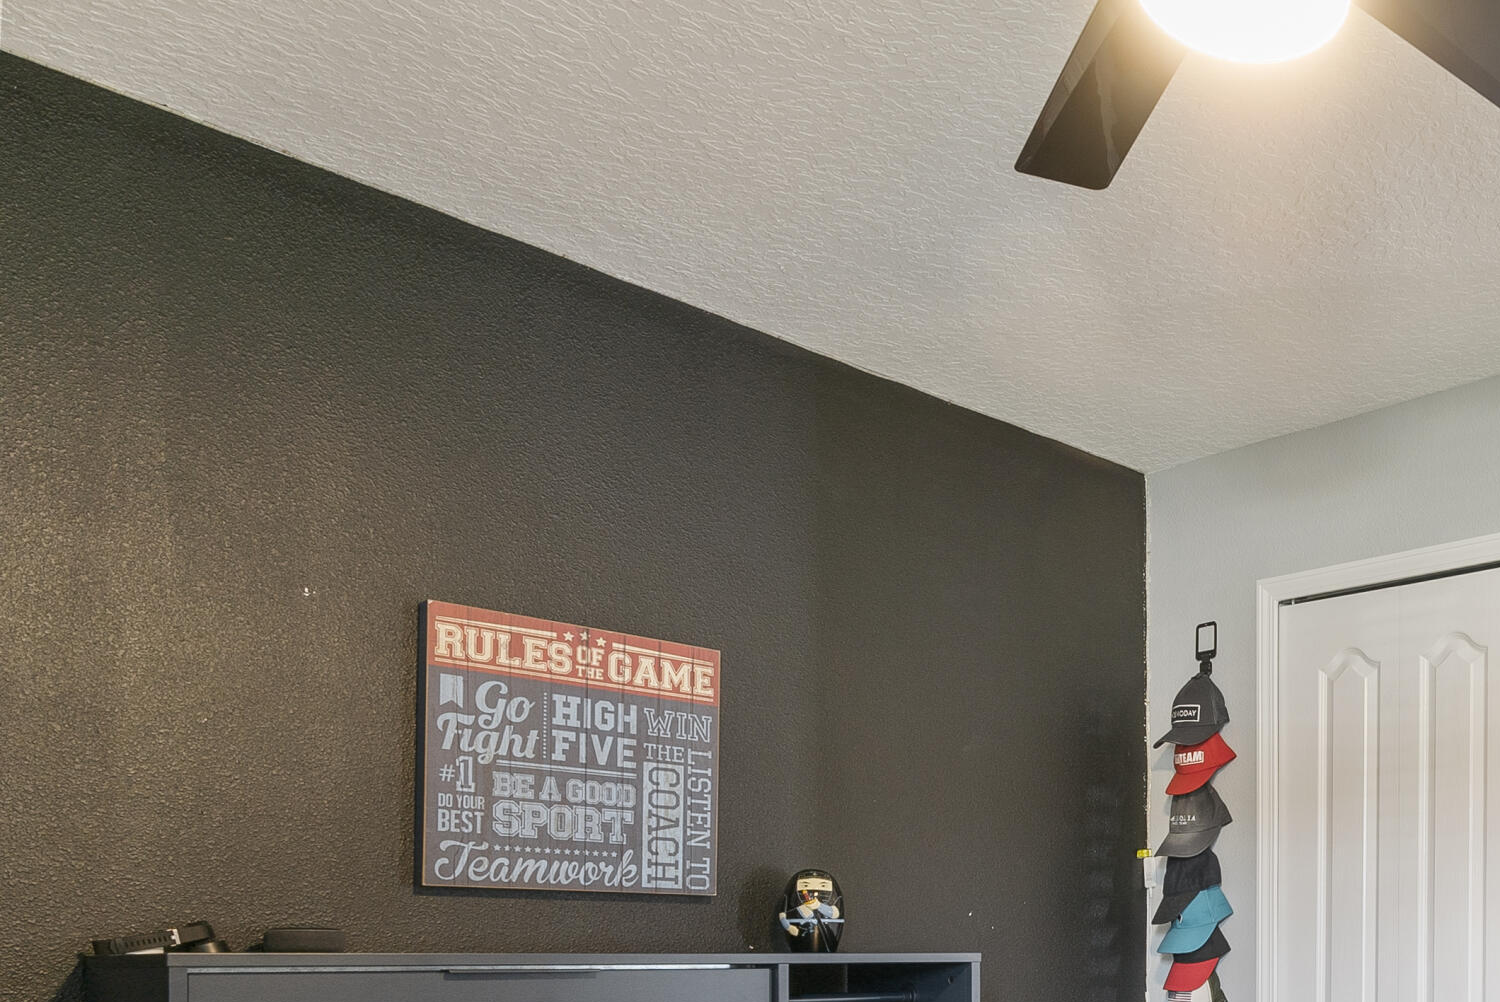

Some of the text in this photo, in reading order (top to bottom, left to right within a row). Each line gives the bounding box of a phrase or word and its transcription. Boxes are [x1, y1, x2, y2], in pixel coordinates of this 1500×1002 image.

[434, 620, 715, 698] RULES OF THE GAME
[475, 680, 536, 730] Go
[551, 693, 638, 735] HIGH
[643, 707, 713, 743] WIN
[436, 711, 540, 765] Fight
[551, 729, 638, 769] FIVE
[643, 742, 685, 763] THE
[439, 755, 475, 793] #1
[492, 770, 638, 808] BE A GOOD
[437, 808, 485, 834] BEST
[438, 793, 485, 810] DO YOUR
[491, 799, 635, 845] SPORT
[686, 748, 713, 890] LISTEN TO
[646, 765, 681, 887] COACH
[433, 839, 639, 888] Teamwork
